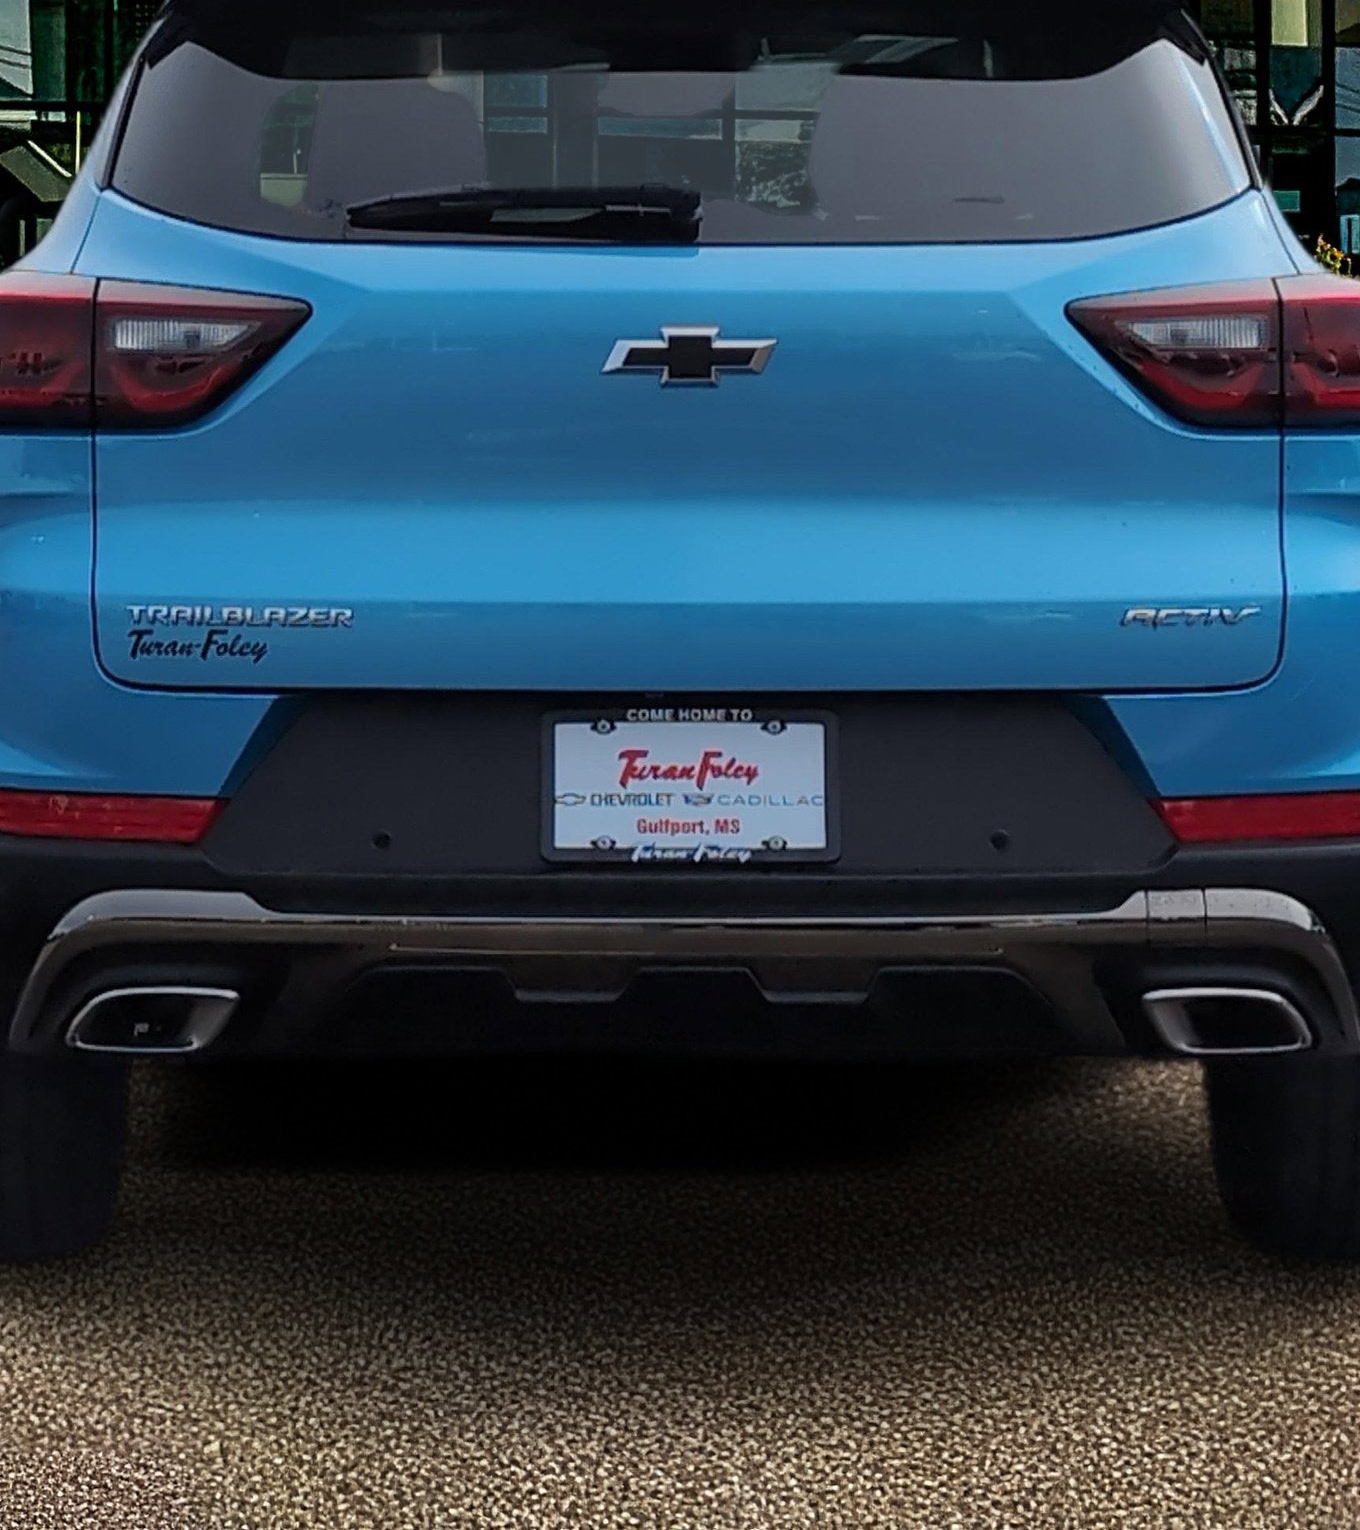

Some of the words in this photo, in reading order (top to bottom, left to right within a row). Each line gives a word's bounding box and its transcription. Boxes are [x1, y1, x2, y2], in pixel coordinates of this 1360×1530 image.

[126, 605, 354, 628] TRAILBLAZER
[1120, 604, 1262, 627] ACTIV
[626, 708, 673, 722] COME
[678, 708, 726, 722] HOME
[730, 708, 753, 722] TO
[590, 792, 674, 807] CHEVROLET
[717, 793, 824, 807] CADILLAC
[636, 817, 710, 837] Gulfport,
[714, 817, 741, 835] MS
